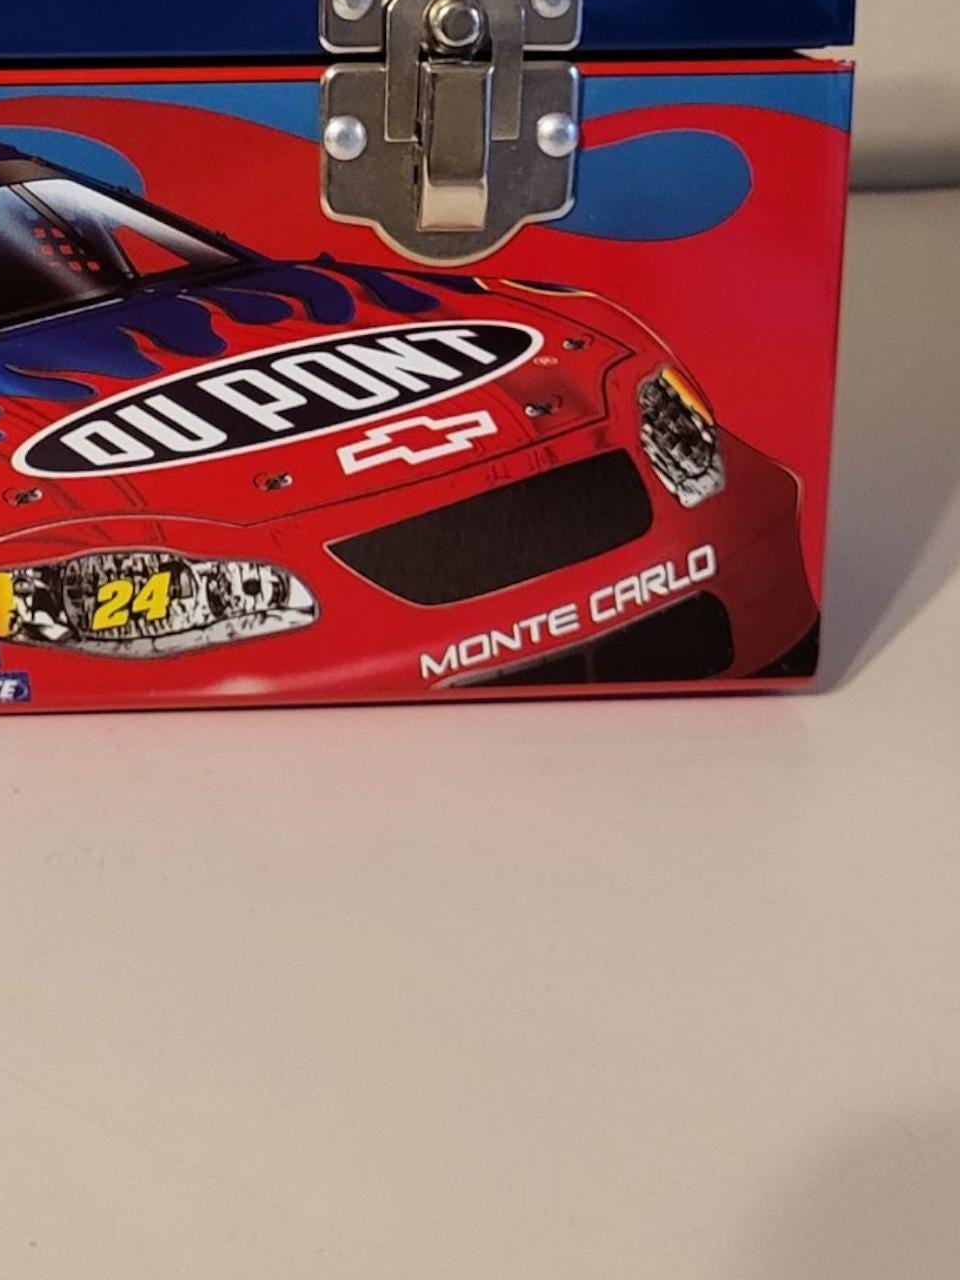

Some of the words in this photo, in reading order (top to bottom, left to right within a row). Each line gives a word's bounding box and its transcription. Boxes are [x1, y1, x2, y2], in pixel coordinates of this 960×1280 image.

[197, 327, 498, 432] PONT
[90, 572, 171, 632] 24
[419, 603, 581, 680] MONTE
[588, 543, 718, 624] CARLO
